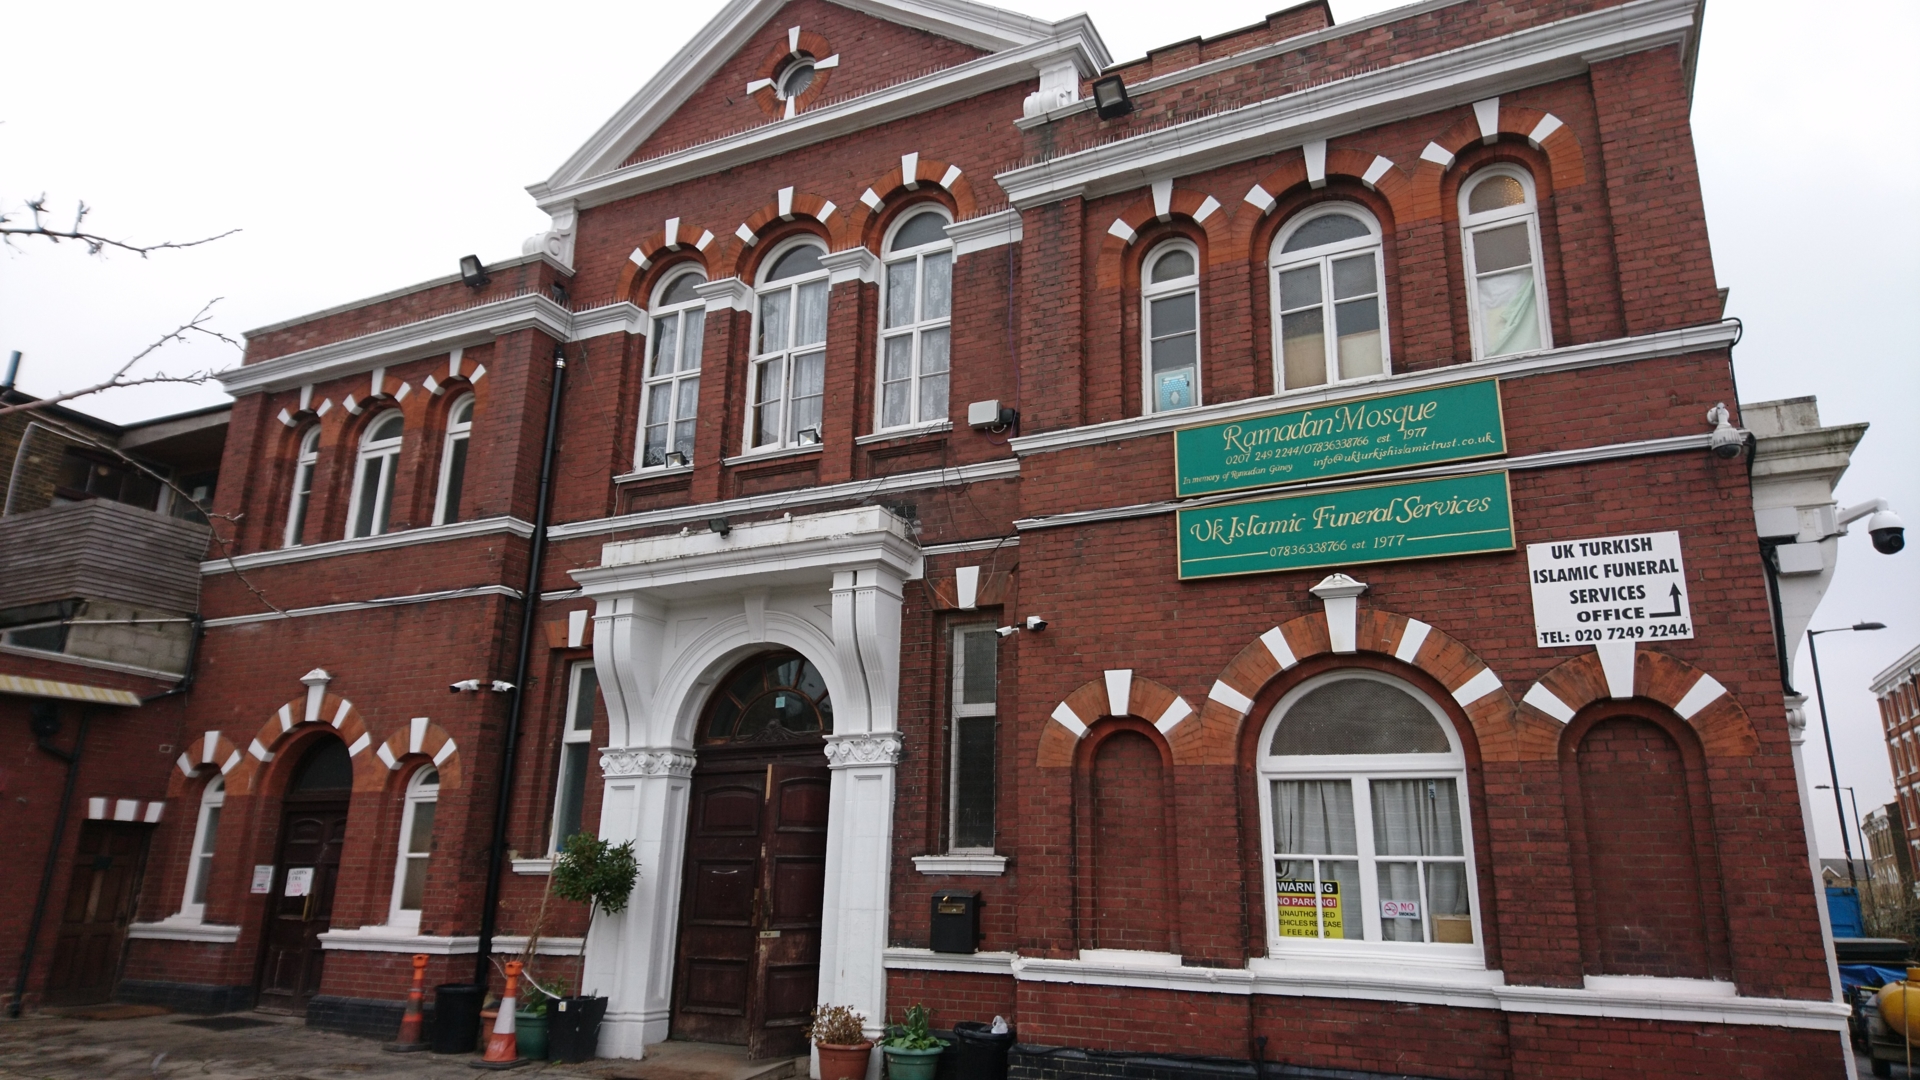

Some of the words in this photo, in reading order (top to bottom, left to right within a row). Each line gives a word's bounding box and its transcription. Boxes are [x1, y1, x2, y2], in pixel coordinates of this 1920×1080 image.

[1223, 411, 1333, 454] Ramadan
[1335, 401, 1437, 432] Mosque
[1225, 453, 1250, 465] 0207
[1255, 450, 1273, 461] 249
[1403, 426, 1428, 440] 1977
[1313, 432, 1495, 470] info@ukturkishislamictrust.co.uk
[1192, 474, 1220, 483] memory
[1222, 471, 1230, 482] of
[1231, 466, 1266, 479] Ramadan
[1190, 518, 1233, 545] Uk
[1228, 513, 1305, 539] Islamic
[1312, 497, 1402, 530] Funeral
[1396, 495, 1491, 523] Services
[1269, 540, 1347, 557] 07836338766
[1373, 534, 1405, 549] 1977
[1551, 544, 1575, 559] UK
[1579, 537, 1653, 557] TURKISH
[1533, 565, 1599, 584] ISLAMIC
[1604, 558, 1679, 578] FUNERAL
[1569, 585, 1646, 604] SERVICES
[1577, 607, 1645, 622] OFFICE
[1541, 631, 1570, 644] TEL:
[1575, 628, 1602, 642] 020
[1607, 626, 1644, 640] 7249
[1649, 623, 1687, 637] 2244
[1277, 897, 1290, 905] NO
[1292, 897, 1336, 907] PARKNG!
[1400, 902, 1414, 912] NO
[1278, 919, 1308, 927] EHICLES
[1309, 920, 1342, 928] REEASE
[1287, 928, 1302, 936] FEE
